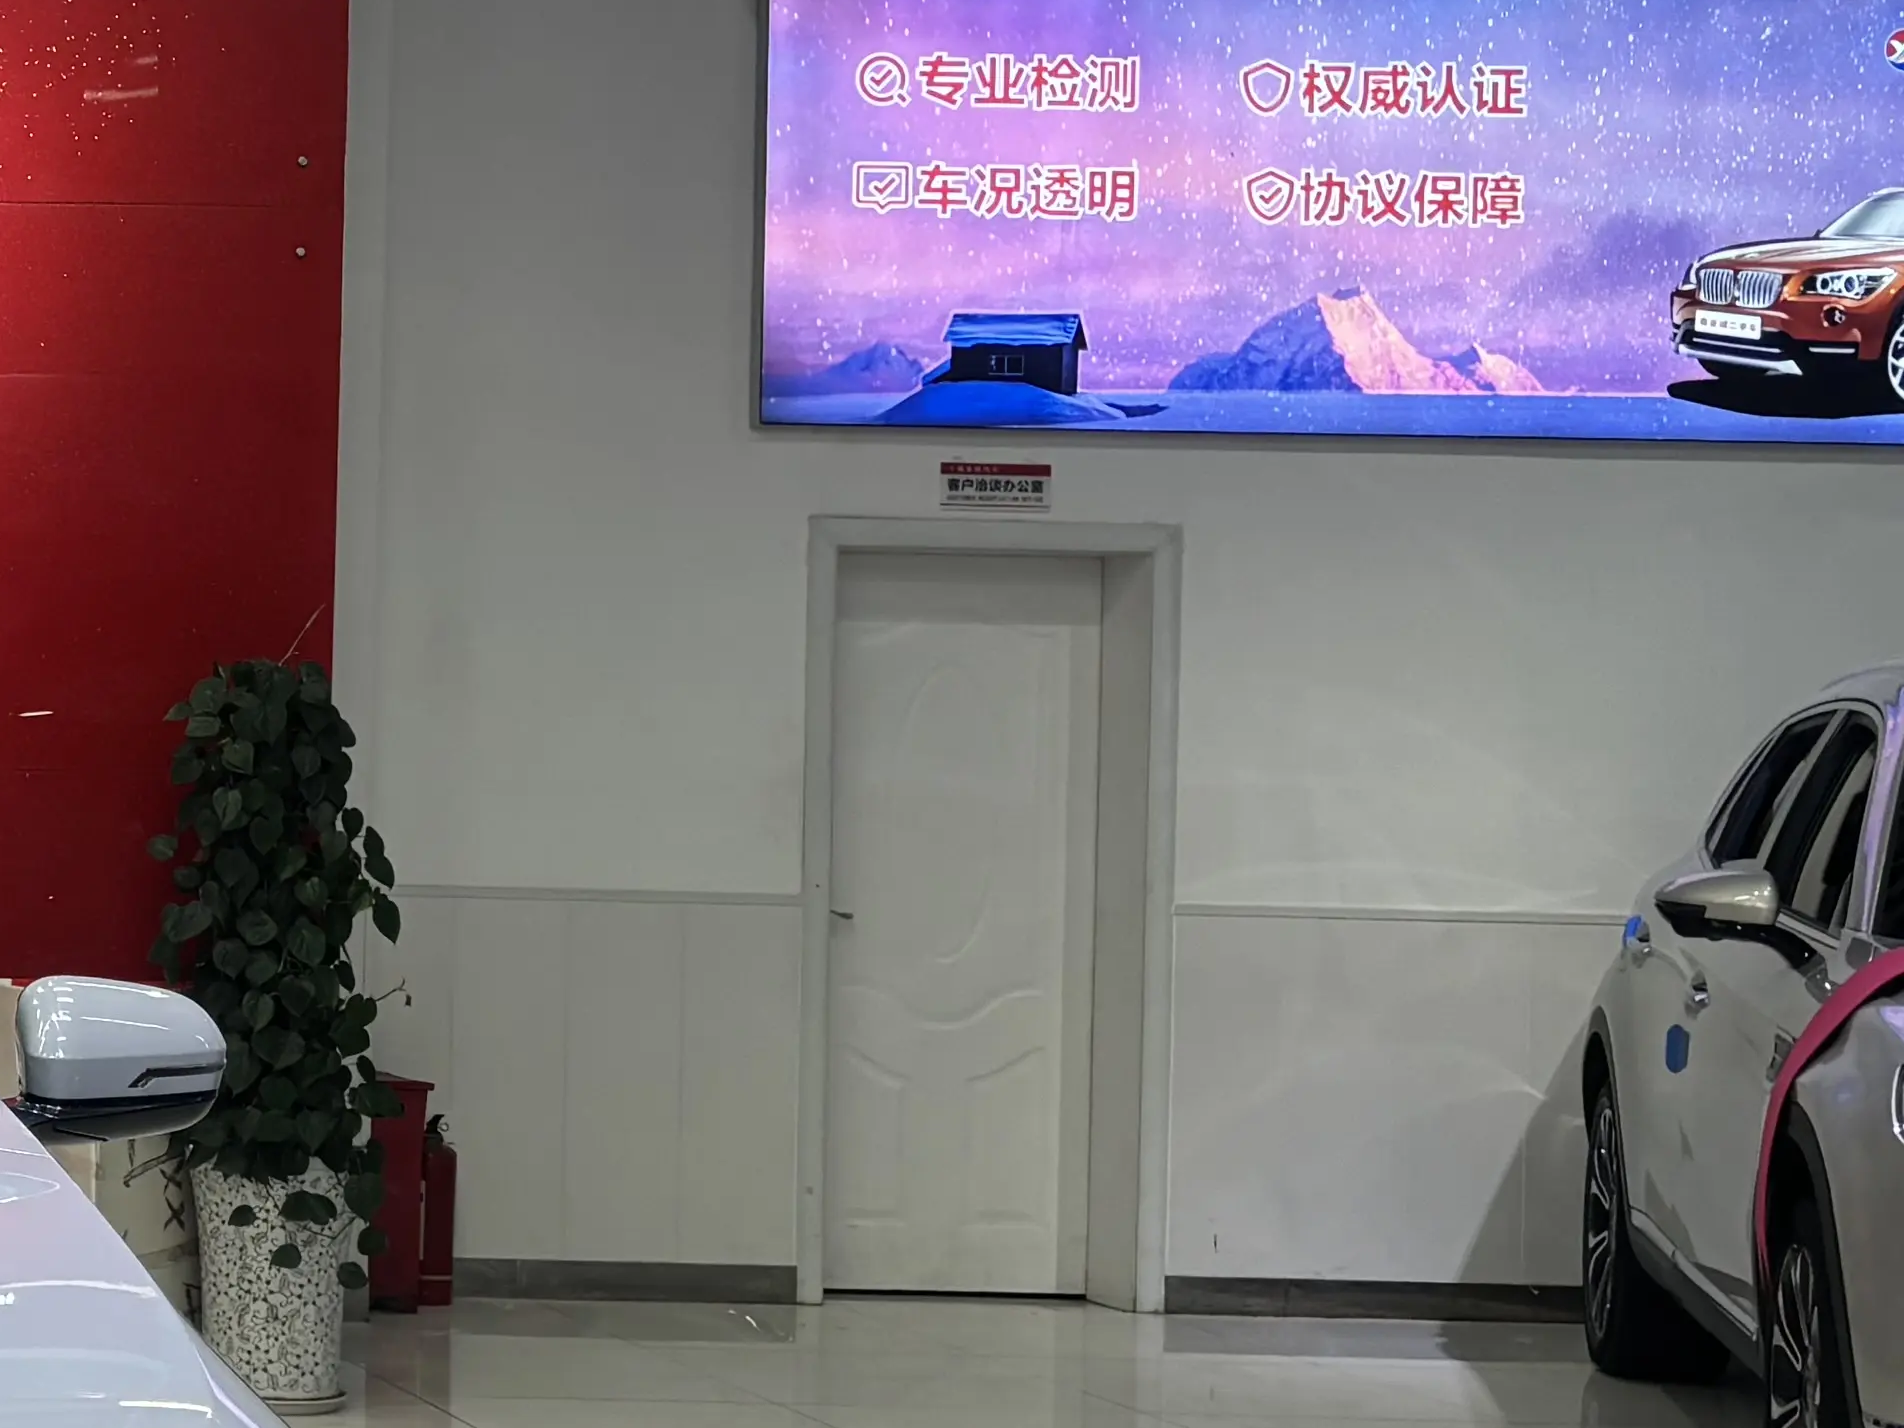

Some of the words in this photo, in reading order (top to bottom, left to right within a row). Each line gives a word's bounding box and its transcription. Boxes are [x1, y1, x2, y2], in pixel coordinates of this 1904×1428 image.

[917, 53, 1140, 112] 专业检测
[1301, 60, 1527, 117] 权威认证
[915, 162, 1139, 221] 车况透明
[1297, 169, 1525, 227] 协议保障
[948, 478, 1044, 493] 客户洽谈办公室
